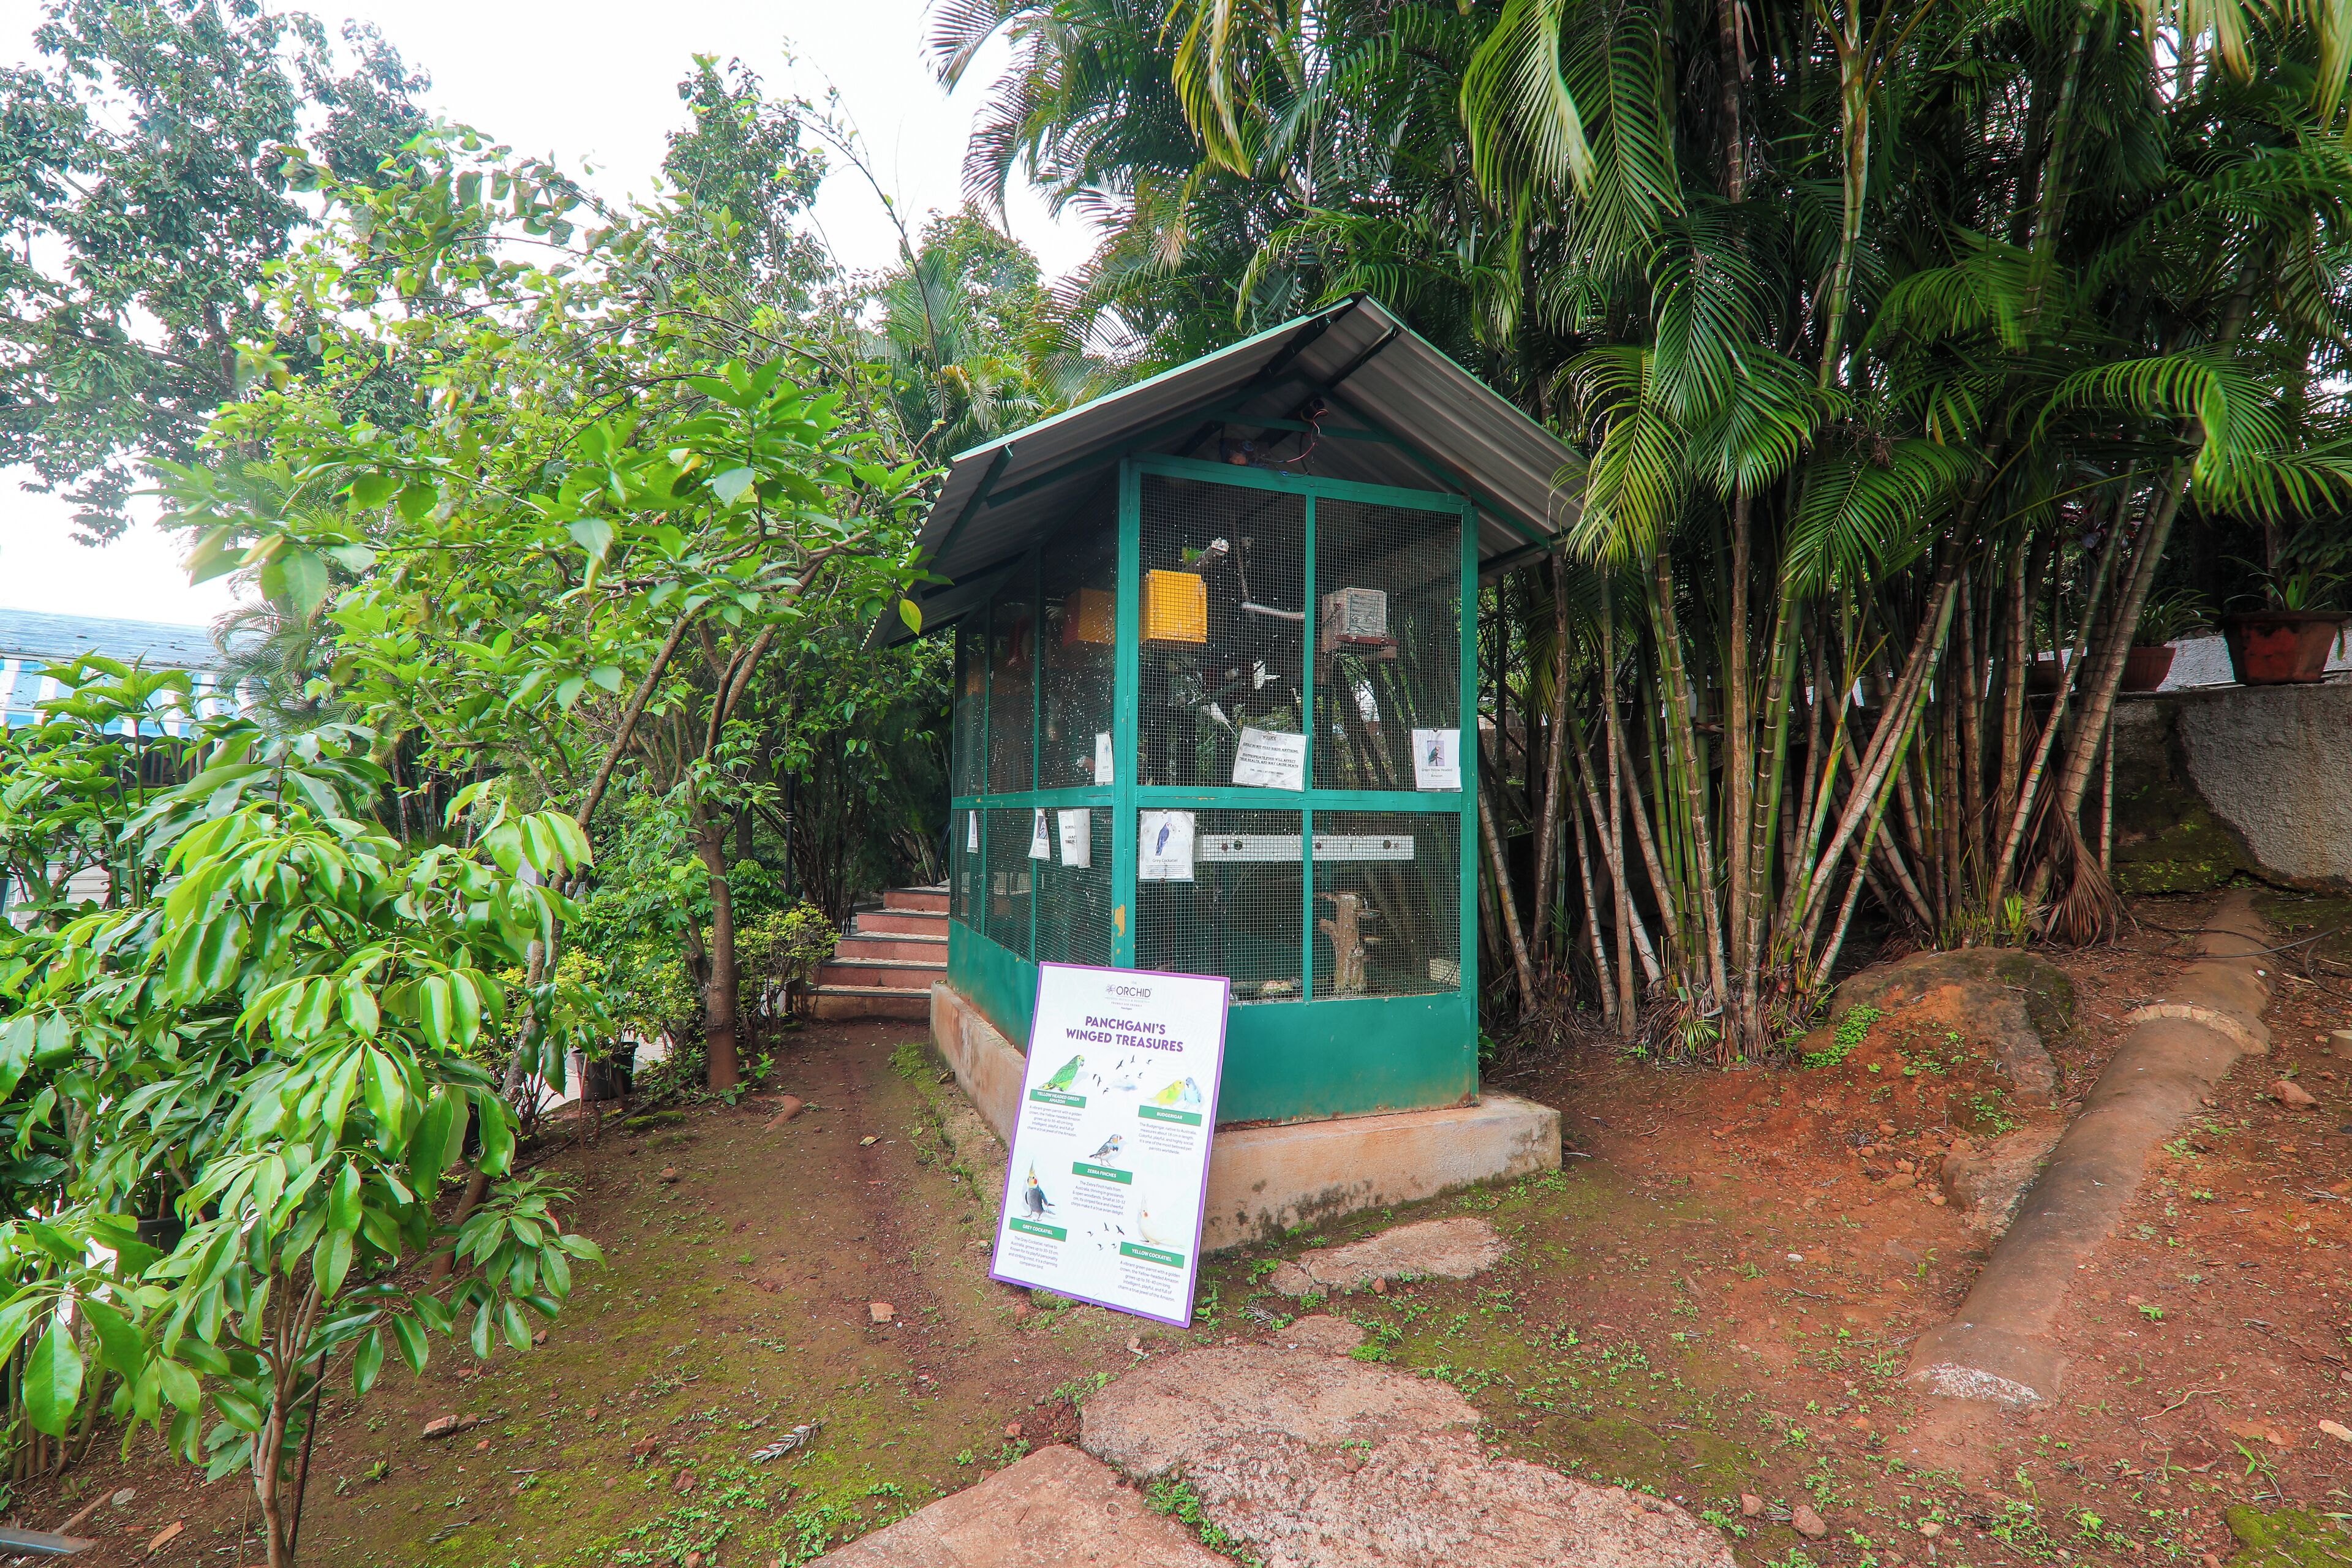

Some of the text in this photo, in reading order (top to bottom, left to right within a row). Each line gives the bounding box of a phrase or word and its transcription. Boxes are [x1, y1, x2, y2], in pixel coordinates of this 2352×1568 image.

[1117, 986, 1150, 997] ORCHID
[1085, 1016, 1166, 1035] PANCHGANI'S
[1066, 1028, 1183, 1052] WINGED TREASURES
[1033, 1226, 1053, 1235] COCKATIEL
[1149, 1253, 1172, 1262] COCKATIEL
